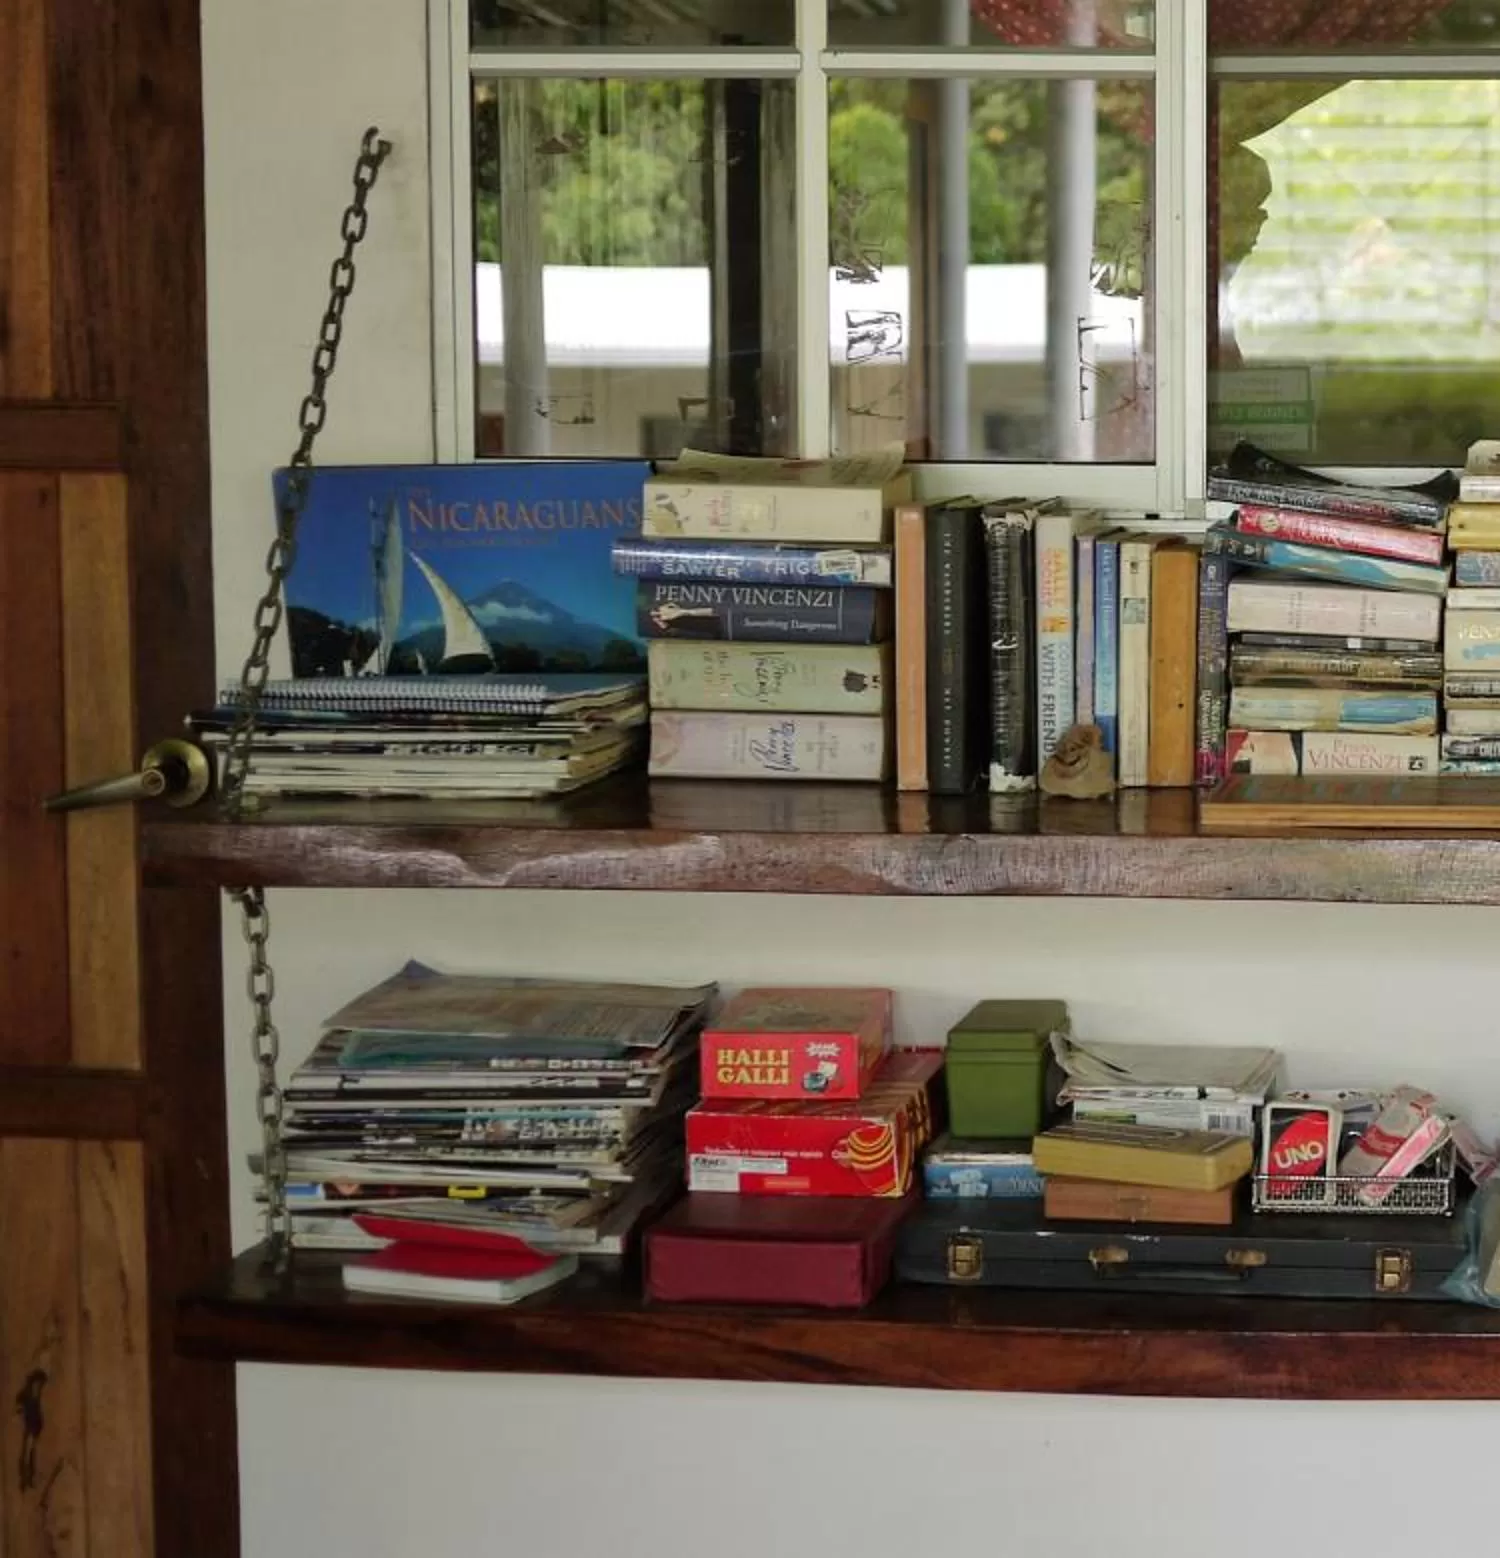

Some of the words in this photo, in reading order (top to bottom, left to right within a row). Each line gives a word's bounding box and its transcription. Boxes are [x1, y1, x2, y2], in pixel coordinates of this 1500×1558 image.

[408, 498, 641, 531] NICARAGUANS
[662, 563, 741, 578] SAWYER
[655, 585, 727, 604] PENNY
[730, 588, 834, 609] VINCENZI
[1041, 643, 1056, 688] WITH
[1309, 749, 1402, 769] VINCENZI
[717, 1049, 789, 1066] HALLI
[716, 1067, 789, 1084] GALLI
[1275, 1141, 1323, 1169] UNO
